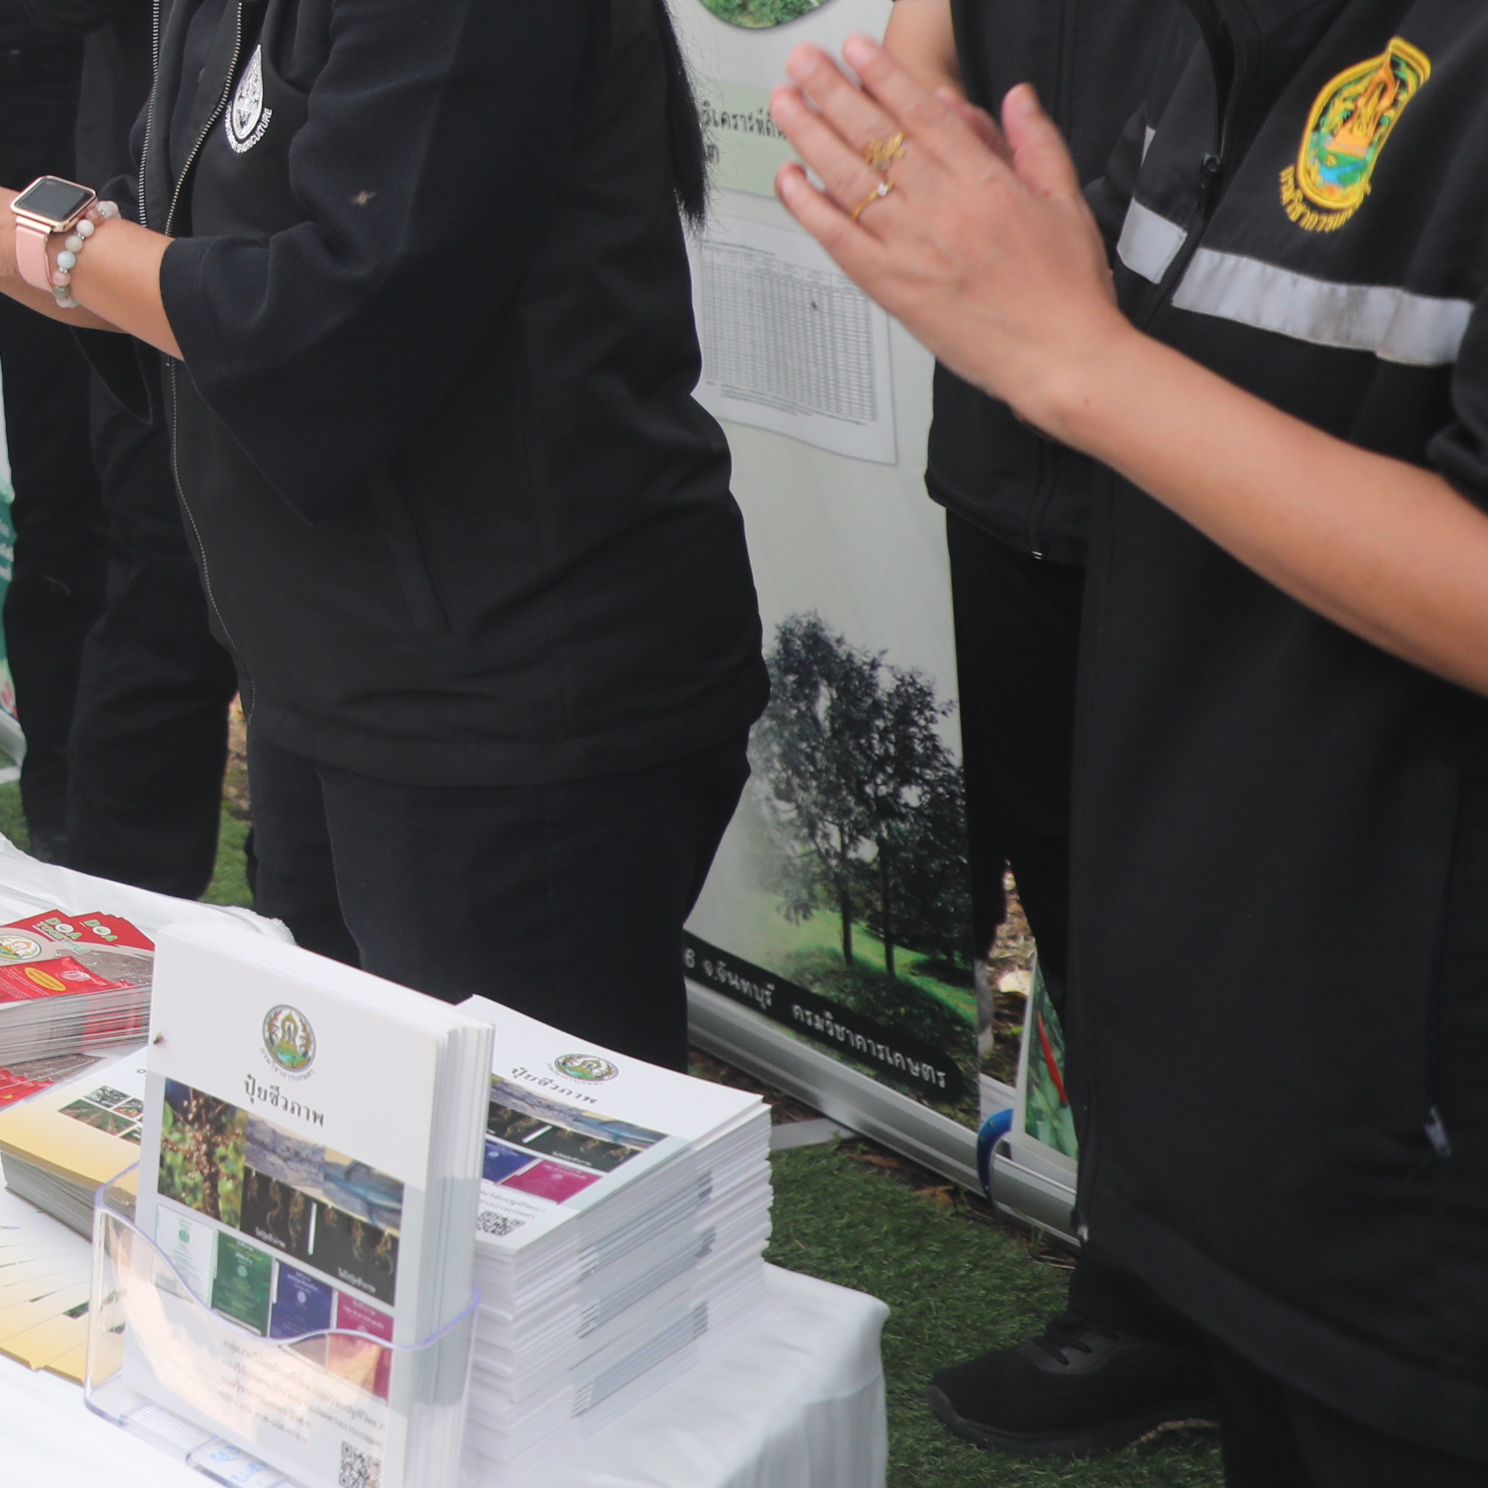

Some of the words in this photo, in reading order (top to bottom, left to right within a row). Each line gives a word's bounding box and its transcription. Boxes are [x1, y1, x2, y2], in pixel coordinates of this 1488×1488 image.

[704, 960, 774, 1010] จ.จันทบุรี
[791, 1004, 946, 1089] กรมวิชาการเกษตร
[244, 1074, 324, 1127] ปุ๋ยชีวภาพ
[511, 1066, 598, 1105] ปุ๋ยชีวภาพ
